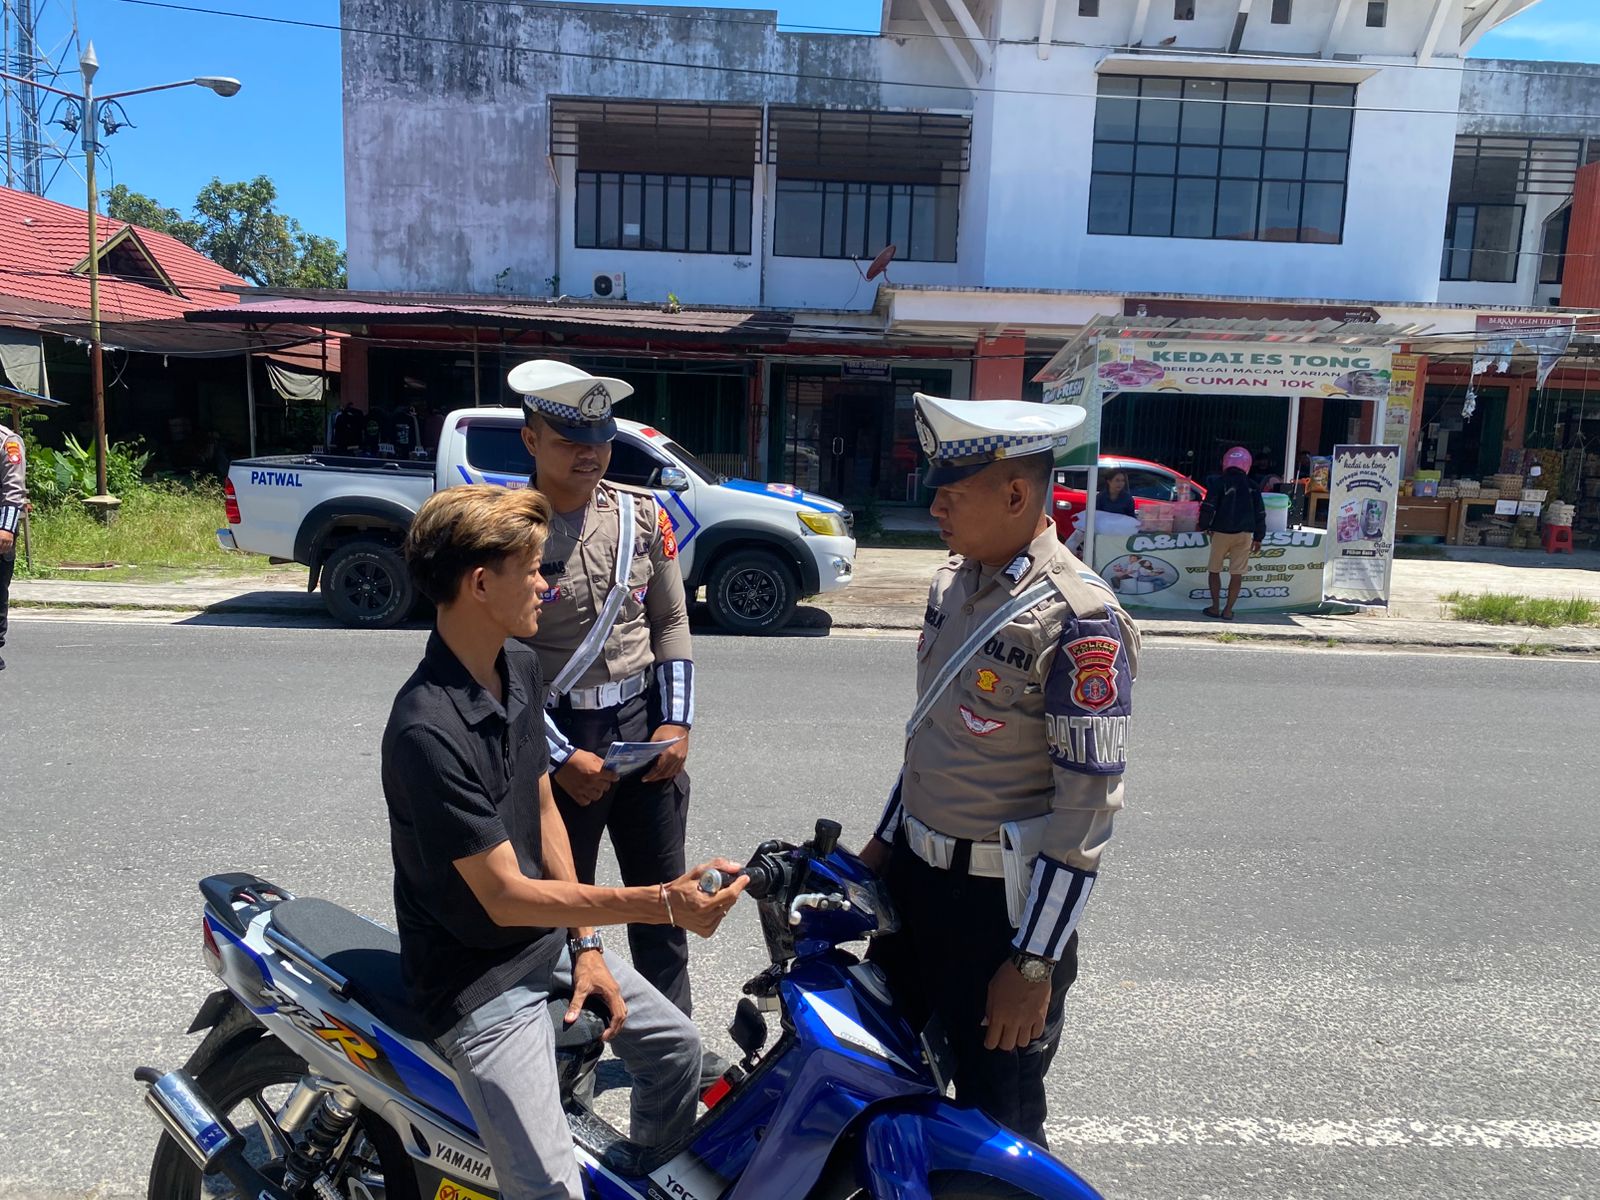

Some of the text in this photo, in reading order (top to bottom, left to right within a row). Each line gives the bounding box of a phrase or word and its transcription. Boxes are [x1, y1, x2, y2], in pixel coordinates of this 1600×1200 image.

[1152, 351, 1371, 369] KEDAI ES TONG
[1185, 376, 1315, 389] CUMAN 10K
[251, 471, 302, 487] PATWAL
[1132, 532, 1205, 551] A&M
[983, 637, 1033, 671] OLRI
[1072, 640, 1116, 654] POLRES
[435, 1142, 491, 1180] YAMAHA
